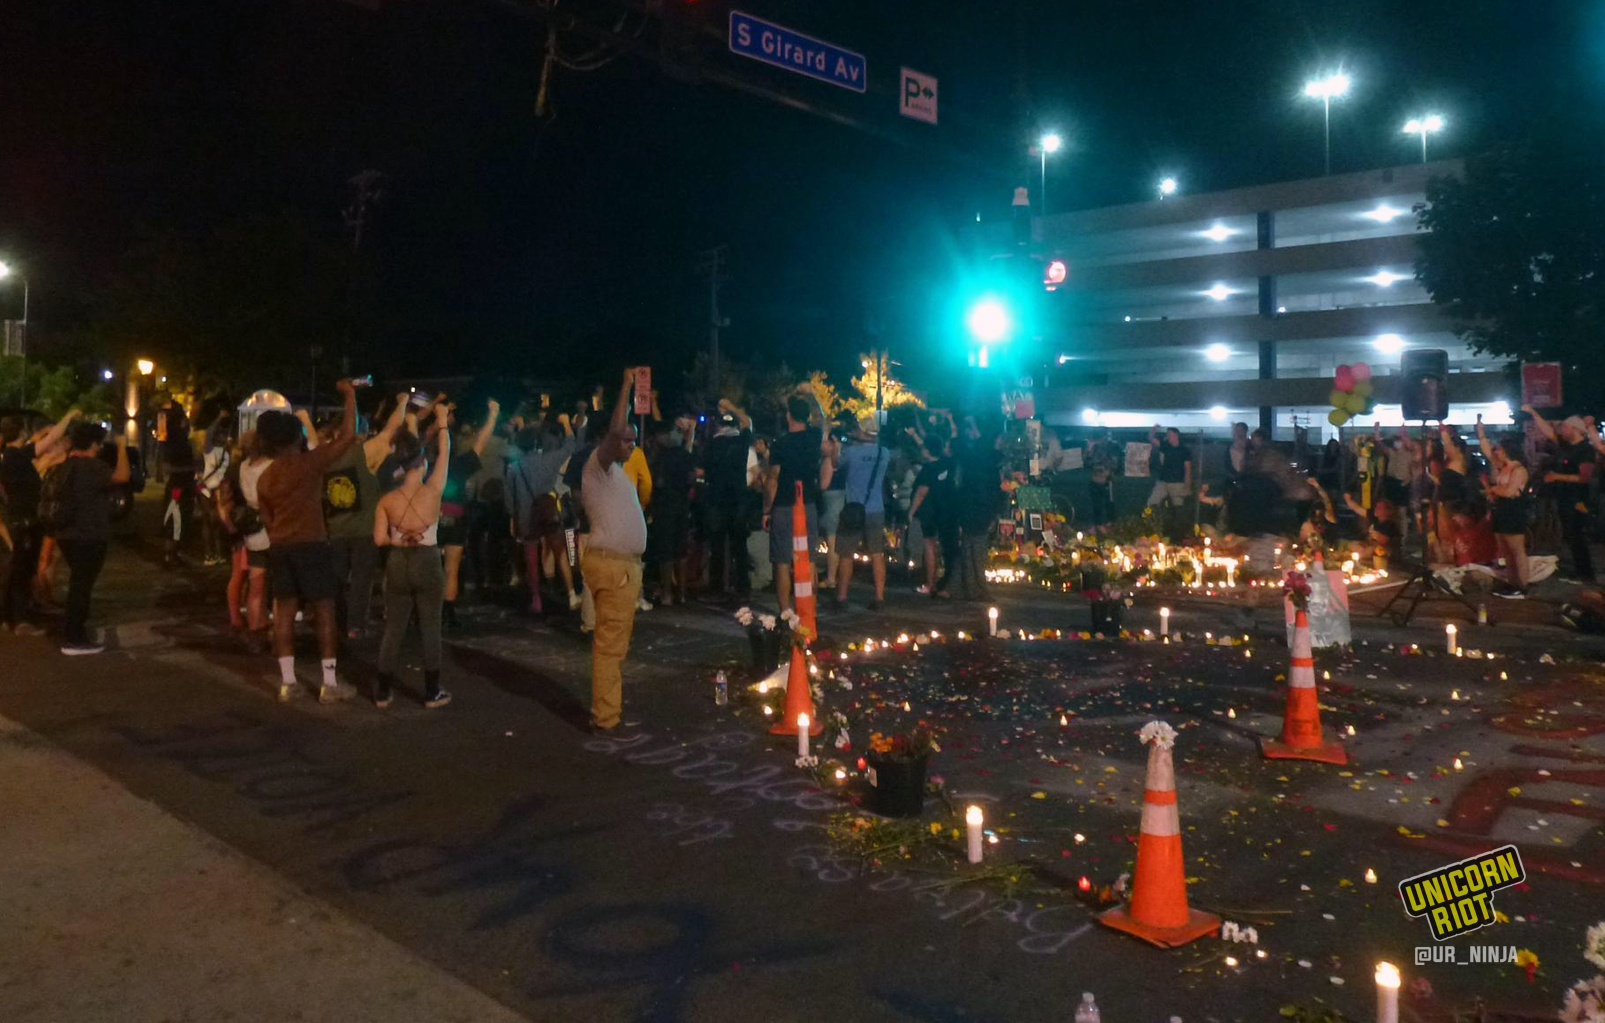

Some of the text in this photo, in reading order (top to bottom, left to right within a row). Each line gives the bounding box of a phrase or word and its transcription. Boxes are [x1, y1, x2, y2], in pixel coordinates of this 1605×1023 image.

[737, 22, 860, 83] S Girard Av
